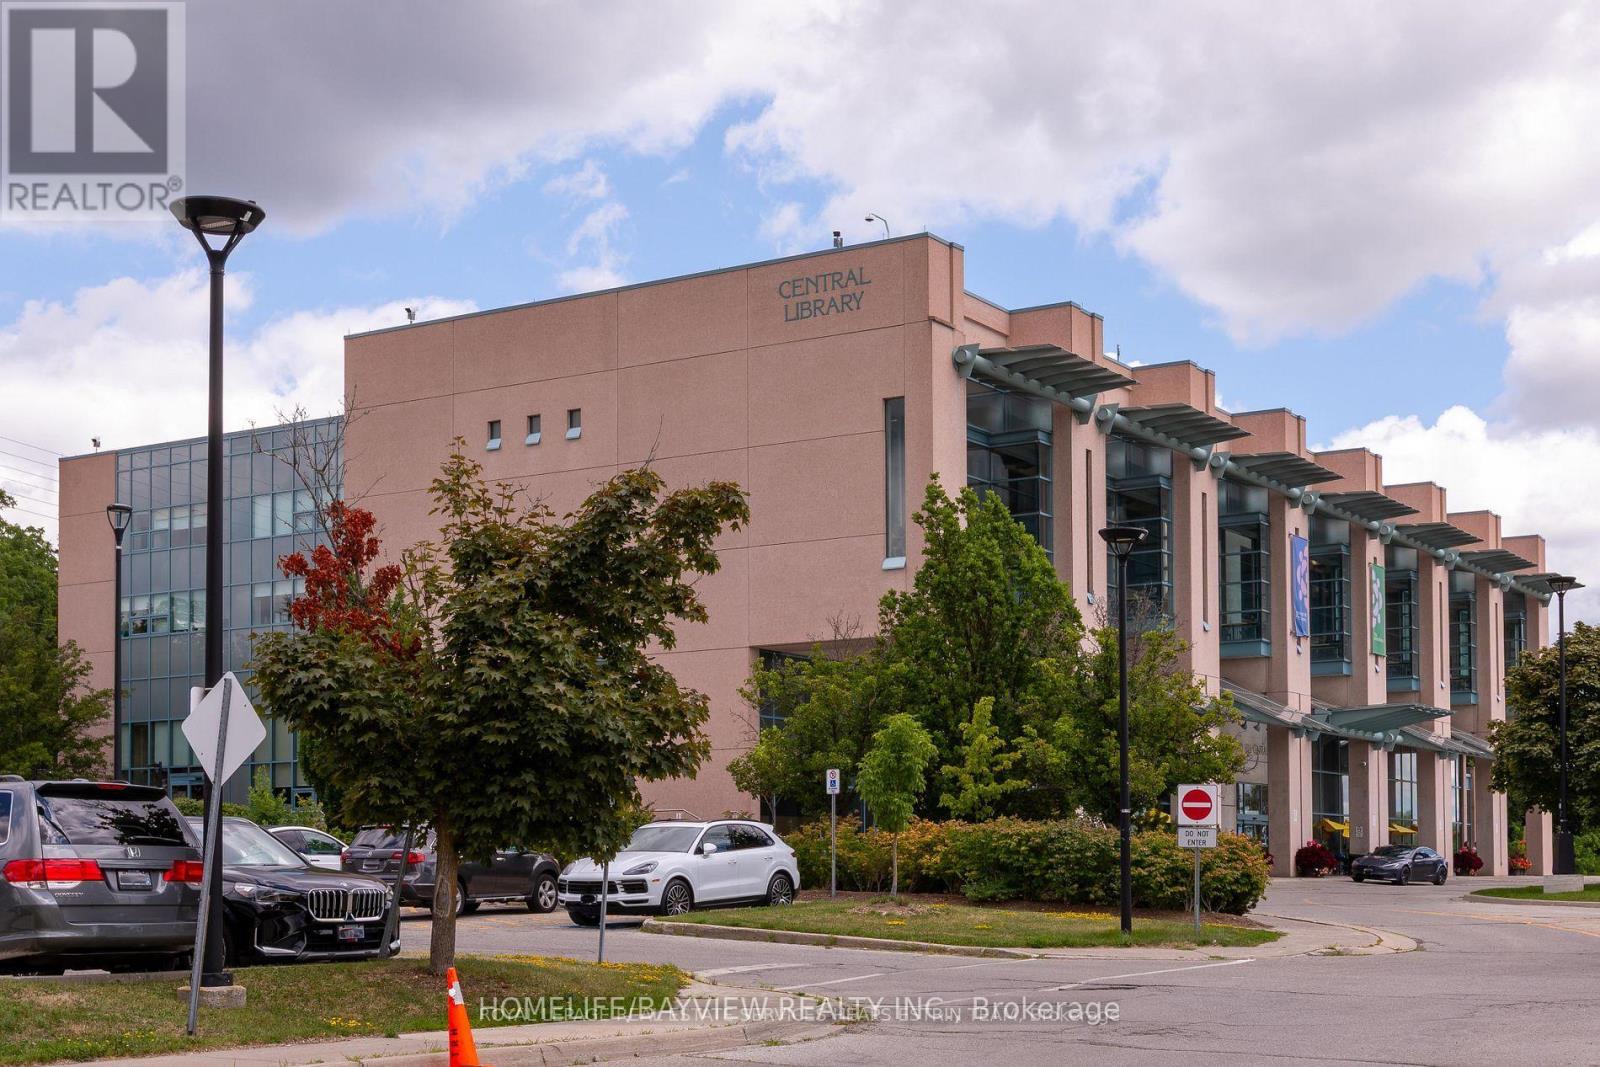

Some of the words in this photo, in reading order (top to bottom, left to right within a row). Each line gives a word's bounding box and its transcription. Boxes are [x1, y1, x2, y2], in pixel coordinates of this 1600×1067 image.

[778, 266, 872, 299] CENTRAL
[784, 290, 865, 323] LIBRARY
[1185, 830, 1194, 838] DO
[1197, 830, 1210, 838] NOT
[1187, 839, 1207, 847] ENTER
